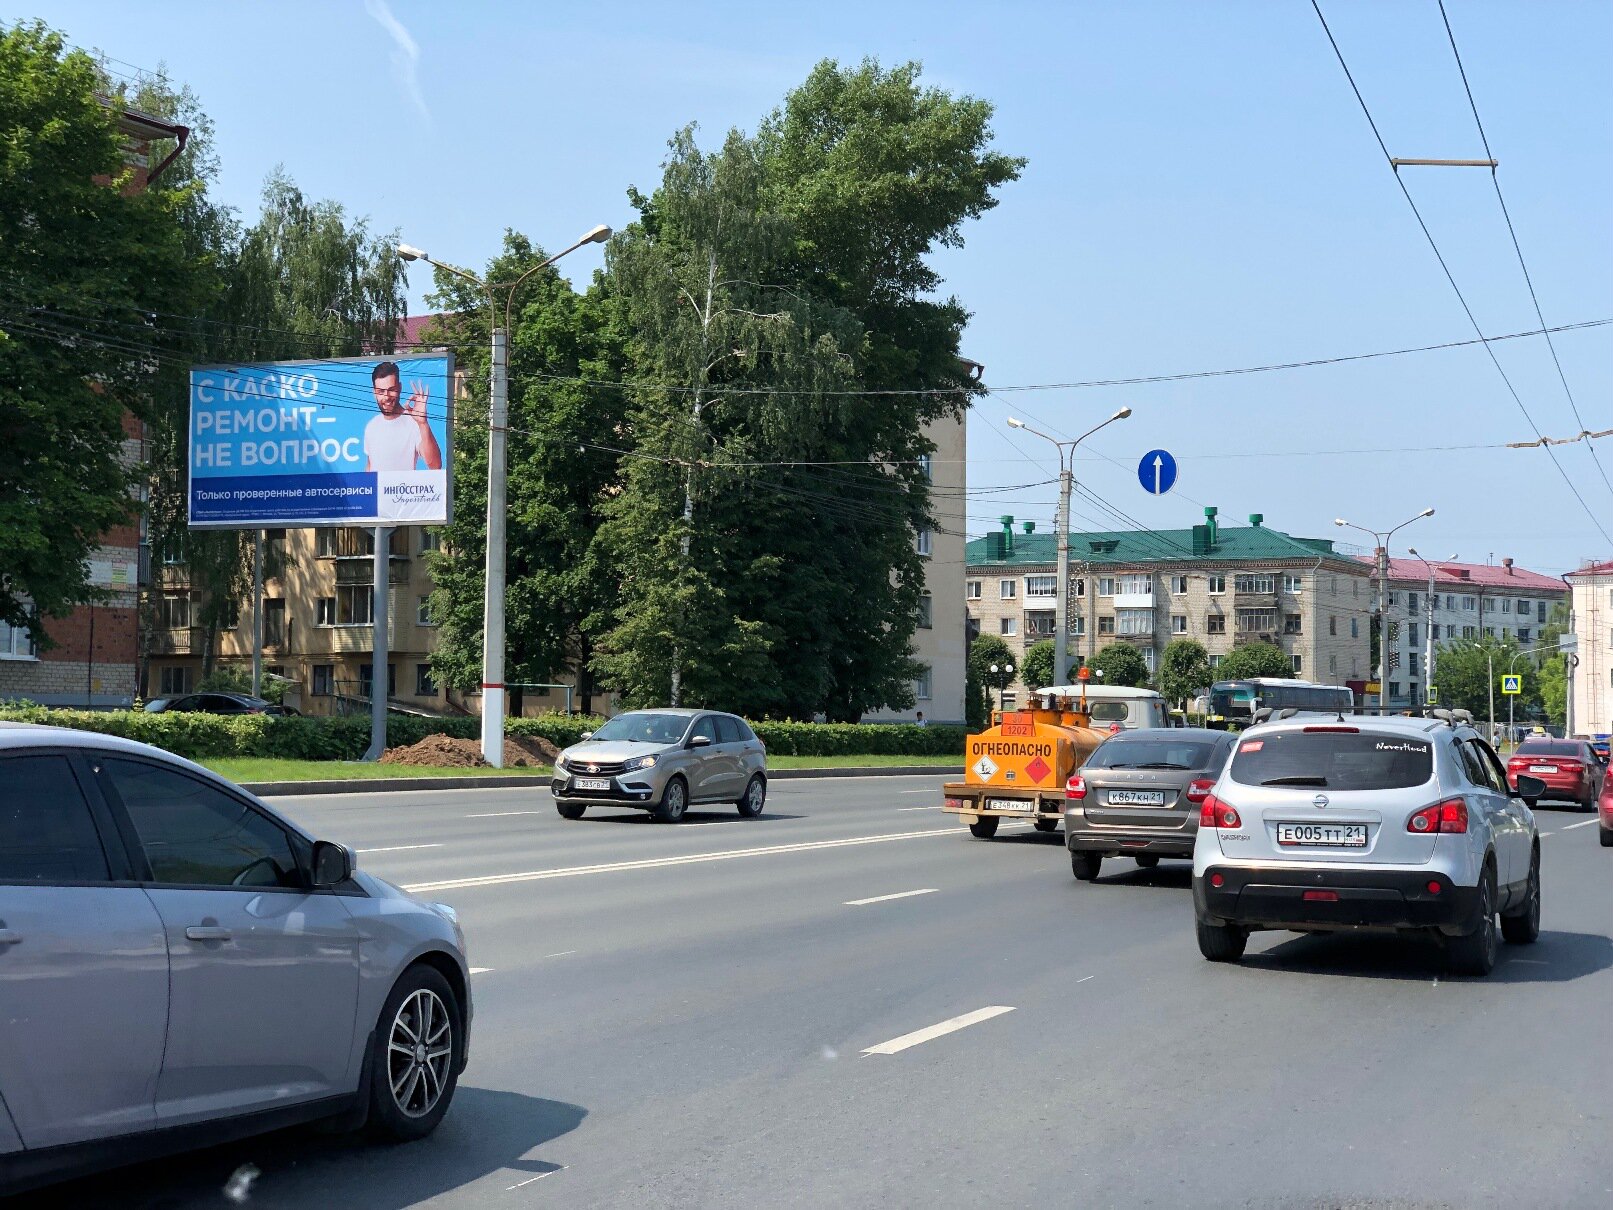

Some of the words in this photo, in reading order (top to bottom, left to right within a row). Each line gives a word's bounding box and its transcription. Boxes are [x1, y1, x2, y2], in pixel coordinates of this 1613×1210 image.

[197, 379, 215, 403] С
[223, 373, 319, 402] КАСКО
[196, 443, 232, 468] НЕ
[241, 437, 360, 466] ВОПРОС
[196, 490, 231, 500] Только
[233, 488, 303, 500] проверенные
[305, 486, 373, 498] автосервисы
[383, 482, 435, 495] ИНГОССТРАХ
[1007, 725, 1028, 736] 1202
[972, 742, 1052, 757] ОГНЕОПАСНО
